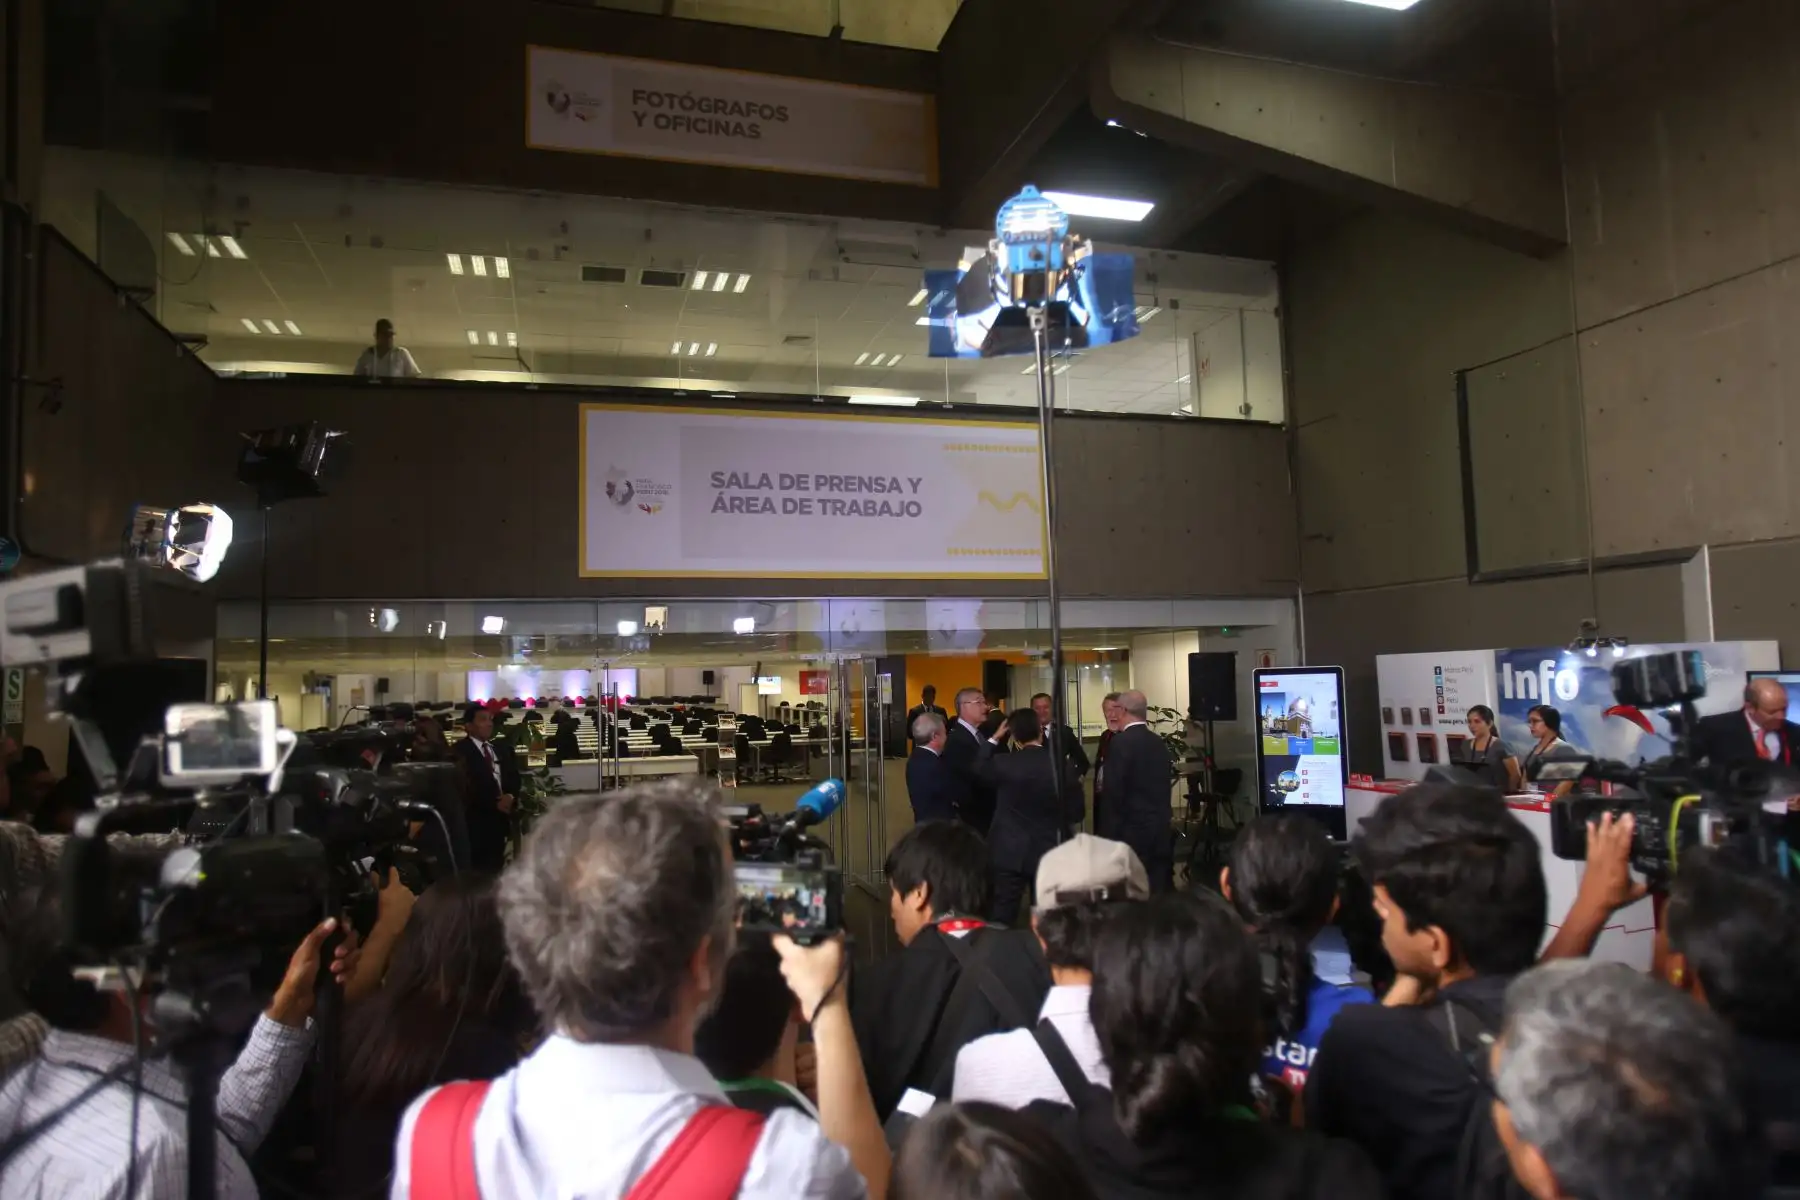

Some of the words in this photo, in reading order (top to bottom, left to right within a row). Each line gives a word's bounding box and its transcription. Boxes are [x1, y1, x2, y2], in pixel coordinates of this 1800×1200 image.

[632, 88, 790, 123] FOTÓGRAFOS
[632, 110, 647, 129] Y
[653, 112, 762, 140] OFICINAS
[710, 471, 774, 490] SALA
[778, 473, 810, 491] DE
[814, 474, 904, 494] PRENSA
[907, 477, 923, 494] Y
[710, 491, 777, 514] ÁREA
[782, 497, 813, 515] DE
[817, 499, 923, 518] TRABAJO
[8, 669, 20, 700] S
[1502, 659, 1580, 705] Info
